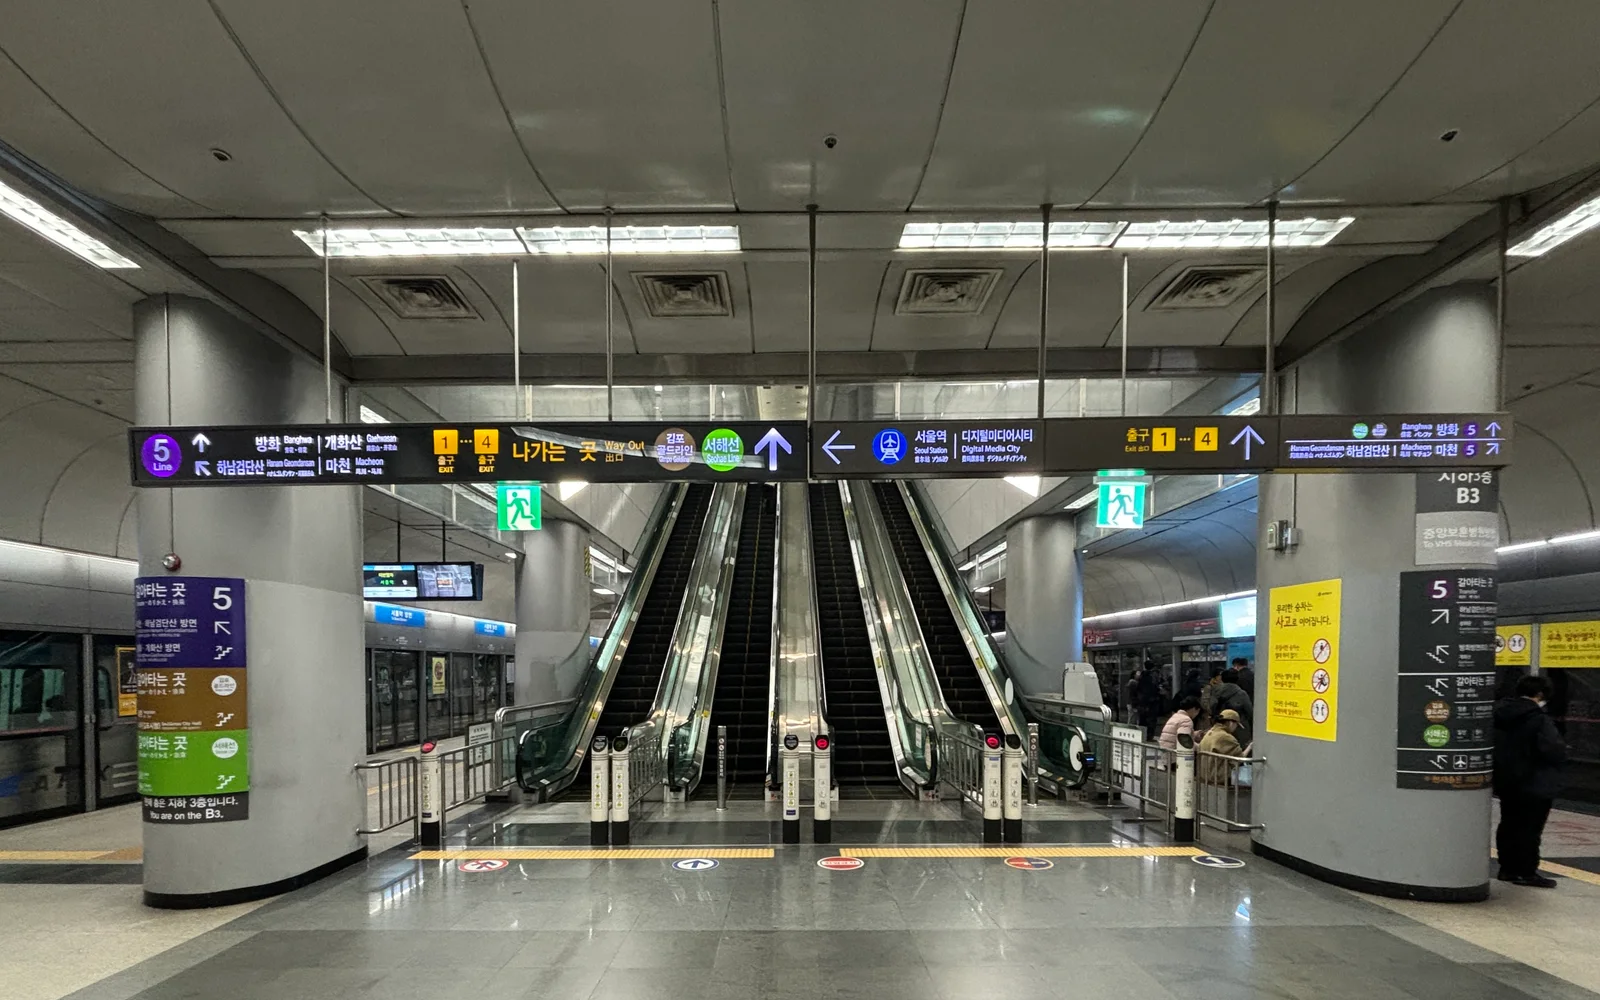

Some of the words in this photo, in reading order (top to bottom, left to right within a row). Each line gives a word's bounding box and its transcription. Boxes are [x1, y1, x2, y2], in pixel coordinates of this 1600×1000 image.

[1402, 423, 1432, 431] Banghwa
[1436, 424, 1460, 436] 방화
[1468, 424, 1476, 436] 5
[283, 435, 312, 445] Banghwa
[366, 434, 397, 443] Gaehwasan
[666, 433, 685, 444] 김포
[914, 430, 946, 444] 서울역
[962, 429, 1032, 442] 디지털미디어시티
[1126, 428, 1150, 442] 출구
[1160, 432, 1168, 446] 1
[1201, 432, 1212, 446] 4
[255, 436, 281, 452] 방화
[324, 434, 362, 450] 개화산
[441, 436, 448, 449] 1
[482, 436, 492, 448] 4
[604, 440, 625, 451] Way
[628, 440, 645, 450] Out
[704, 437, 740, 453] 서해선
[1401, 443, 1432, 451] Macheon
[153, 438, 170, 462] 5
[512, 441, 566, 462] 나가는
[578, 440, 598, 462] 곳
[656, 444, 693, 456] 골드라인
[930, 446, 948, 454] Station
[962, 445, 984, 454] Digital
[984, 444, 1006, 452] Media
[1006, 444, 1020, 453] City
[1346, 444, 1390, 458] 하남검단산
[1436, 444, 1458, 456] 마천
[1466, 444, 1475, 456] 5
[355, 457, 384, 466] Macheon
[438, 456, 456, 465] 출구
[478, 455, 496, 465] 출구
[604, 453, 624, 462] 出口
[706, 454, 726, 463] Seohae
[728, 454, 740, 463] Line
[153, 462, 173, 471] Line
[217, 460, 264, 475] 하남검단산
[325, 458, 350, 474] 마천
[1456, 487, 1480, 504] B3
[1432, 580, 1448, 598] 5
[1458, 578, 1486, 588] 갈아타는
[172, 582, 186, 598] 곳
[212, 586, 232, 610] 5
[1276, 604, 1294, 614] 무리한
[1294, 601, 1314, 612] 승차는
[180, 618, 198, 628] 방면
[1276, 615, 1297, 628] 사고로
[1298, 615, 1332, 626] 이어집니다.
[164, 644, 180, 652] 방면
[172, 672, 186, 686] 곳
[1456, 676, 1484, 686] 갈아타는
[173, 736, 188, 750] 곳
[168, 798, 187, 808] 지하
[190, 796, 238, 808] 3층입니다.
[150, 811, 160, 820] You
[160, 812, 172, 820] are
[187, 812, 202, 820] the
[205, 808, 224, 819] B3.
